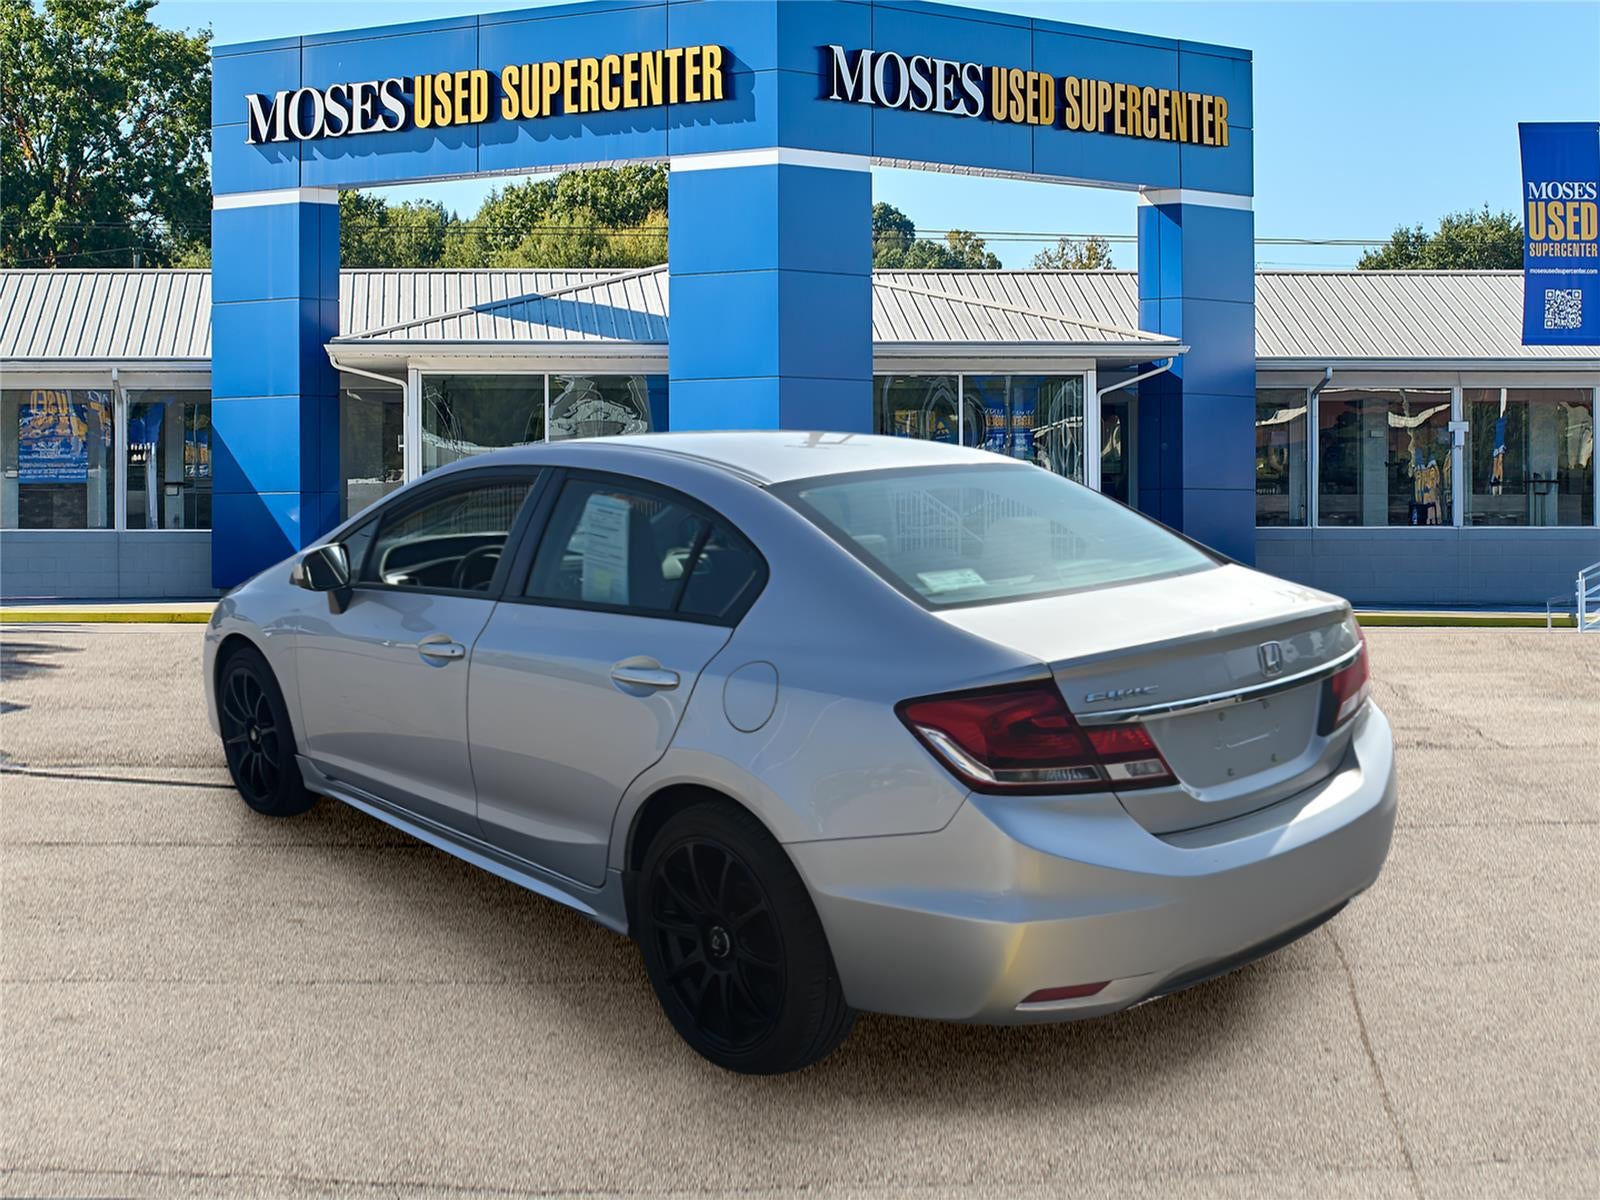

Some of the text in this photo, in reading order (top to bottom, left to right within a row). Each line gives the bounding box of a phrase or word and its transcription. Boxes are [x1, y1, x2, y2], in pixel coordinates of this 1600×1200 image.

[244, 44, 724, 145] MOSES USED SUPERCENTER
[828, 44, 1230, 147] MOSES USED SUPERCENTER
[1527, 181, 1598, 200] MOSES
[1528, 201, 1598, 241] USED
[1529, 242, 1598, 257] SUPERCENTER
[1085, 683, 1160, 703] CIVIC
